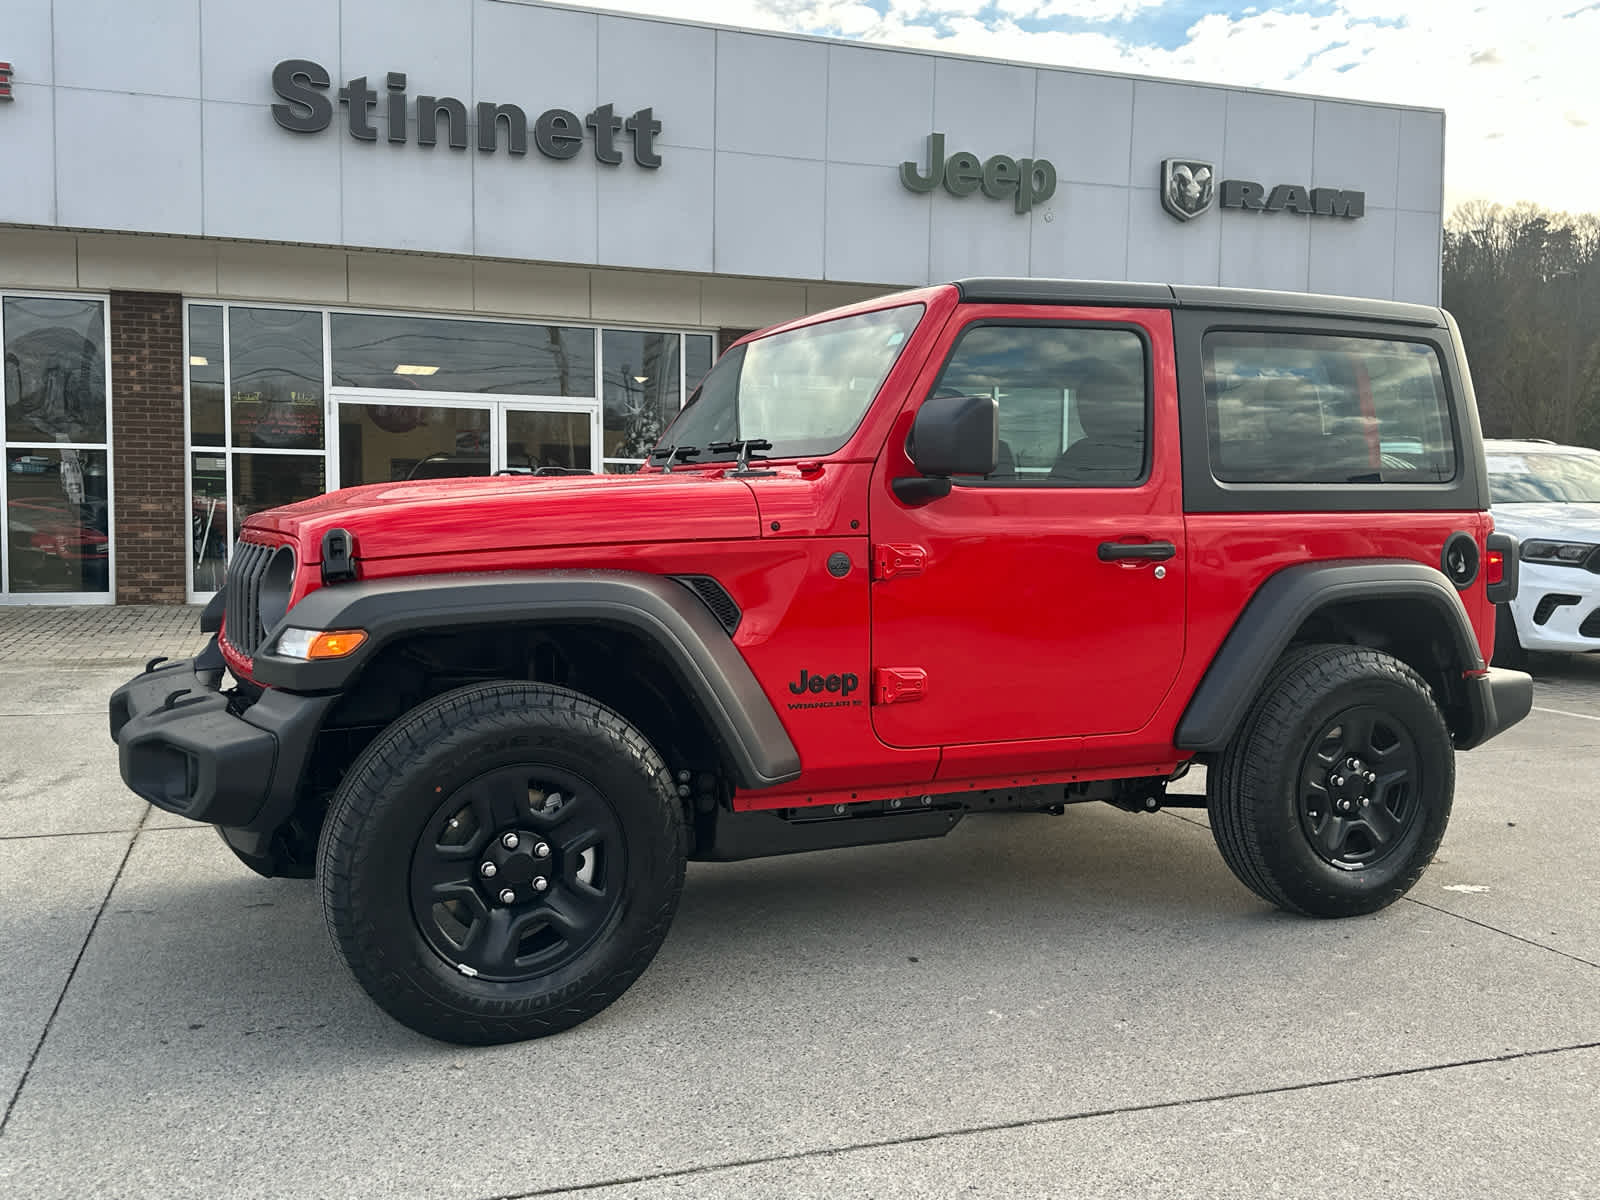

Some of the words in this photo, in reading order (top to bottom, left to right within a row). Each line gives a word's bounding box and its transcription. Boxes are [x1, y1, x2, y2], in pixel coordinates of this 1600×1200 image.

[271, 59, 662, 169] Stinnett
[899, 132, 1057, 214] Jeep
[1220, 179, 1366, 219] RAM
[789, 669, 858, 697] Jeep
[787, 700, 850, 710] WRANGLER
